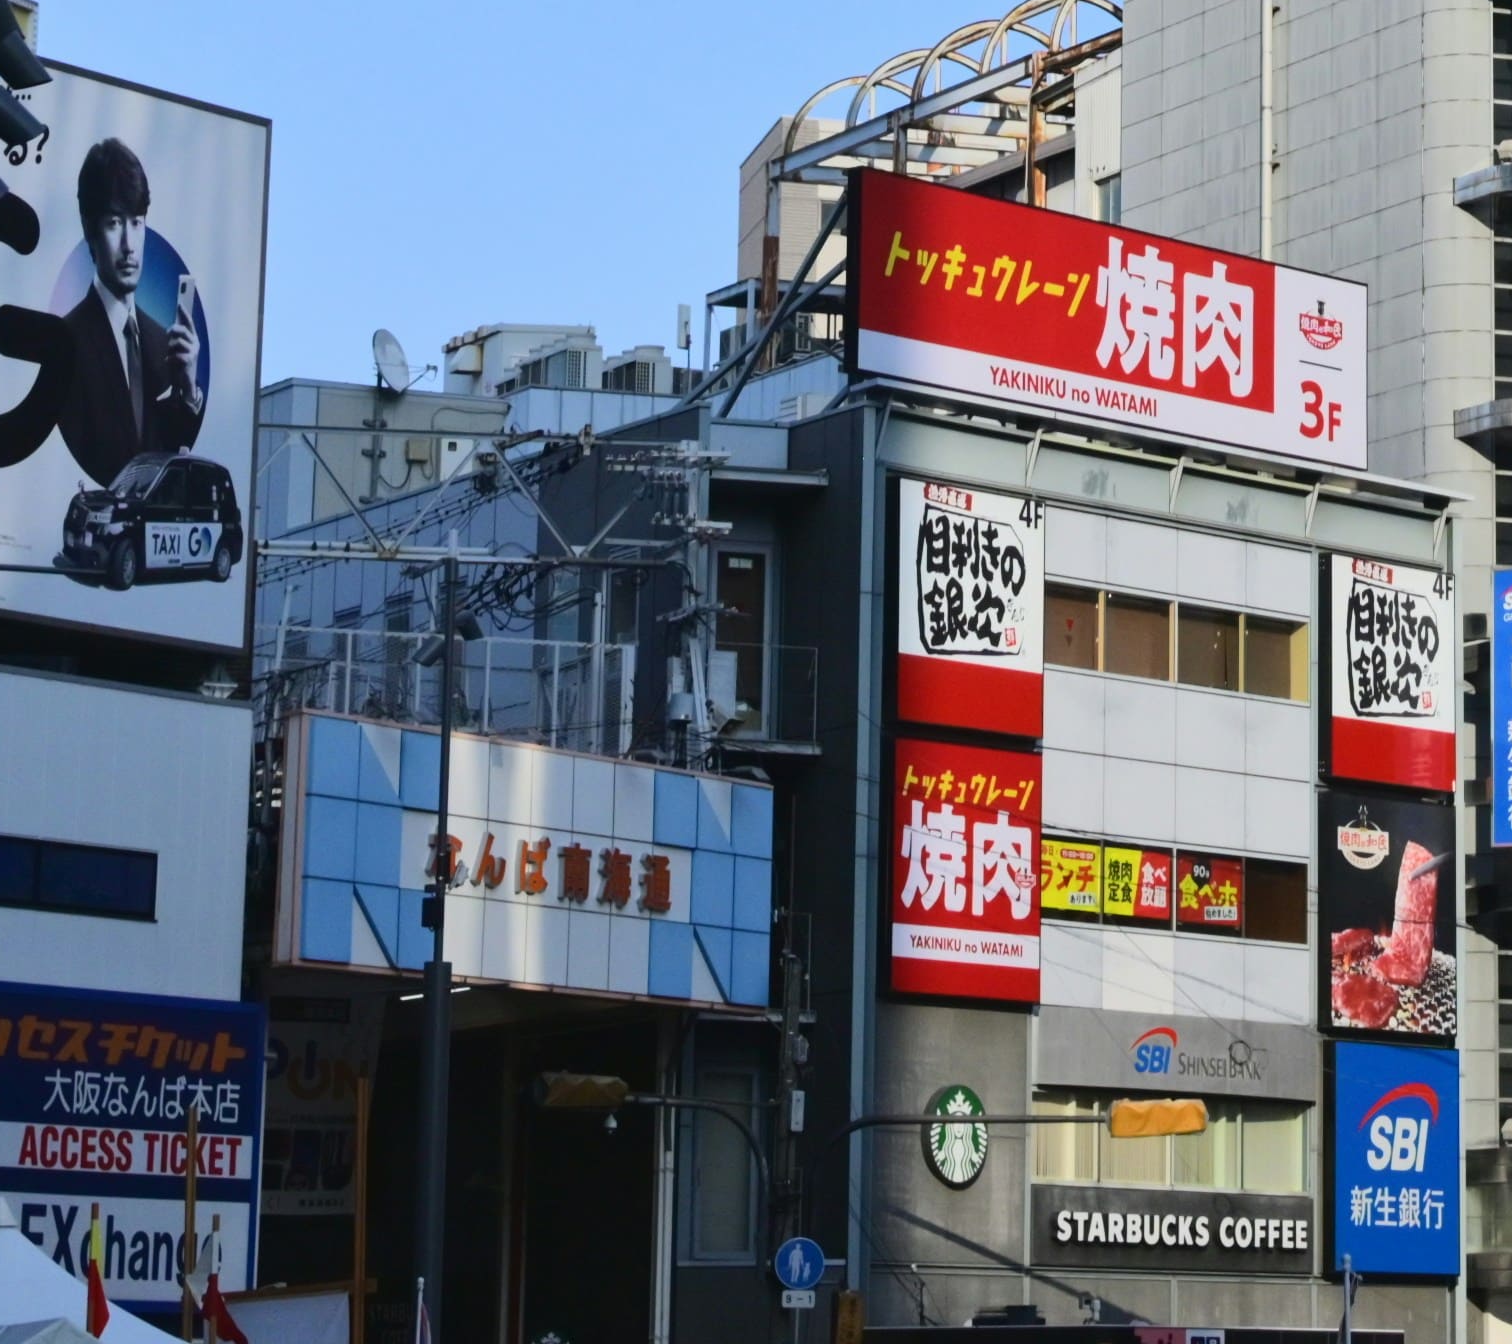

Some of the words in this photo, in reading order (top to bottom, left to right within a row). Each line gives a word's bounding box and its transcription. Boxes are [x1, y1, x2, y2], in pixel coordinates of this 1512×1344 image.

[885, 230, 1090, 318] トッキュウレーン
[1095, 235, 1254, 398] 焼肉
[990, 365, 1067, 400] YAKINIKU
[1071, 388, 1091, 404] no
[1095, 386, 1158, 419] WATAMI
[1299, 380, 1342, 442] 3F
[1019, 499, 1043, 529] 4F
[152, 533, 181, 556] TAXI
[924, 515, 1026, 596] 目利きの
[1433, 573, 1454, 600] 4F
[1352, 588, 1439, 662] 目利きの
[902, 765, 1035, 810] トッキュウレーン
[901, 800, 1033, 920] 焼肉
[1142, 862, 1167, 883] 食べ
[1108, 883, 1133, 904] 定食
[910, 934, 962, 952] YAKINIKU
[964, 943, 977, 953] no
[981, 941, 1023, 958] WATAMI
[1134, 1044, 1171, 1074] SBI
[43, 1069, 241, 1124] 大阪なんば本店
[18, 1125, 133, 1172] ACCESS
[144, 1133, 242, 1177] TICKET
[1366, 1114, 1430, 1173] SBI
[1056, 1210, 1210, 1248] STARBUCKS
[1219, 1216, 1309, 1250] COFFEE
[1350, 1185, 1445, 1231] 新生銀行
